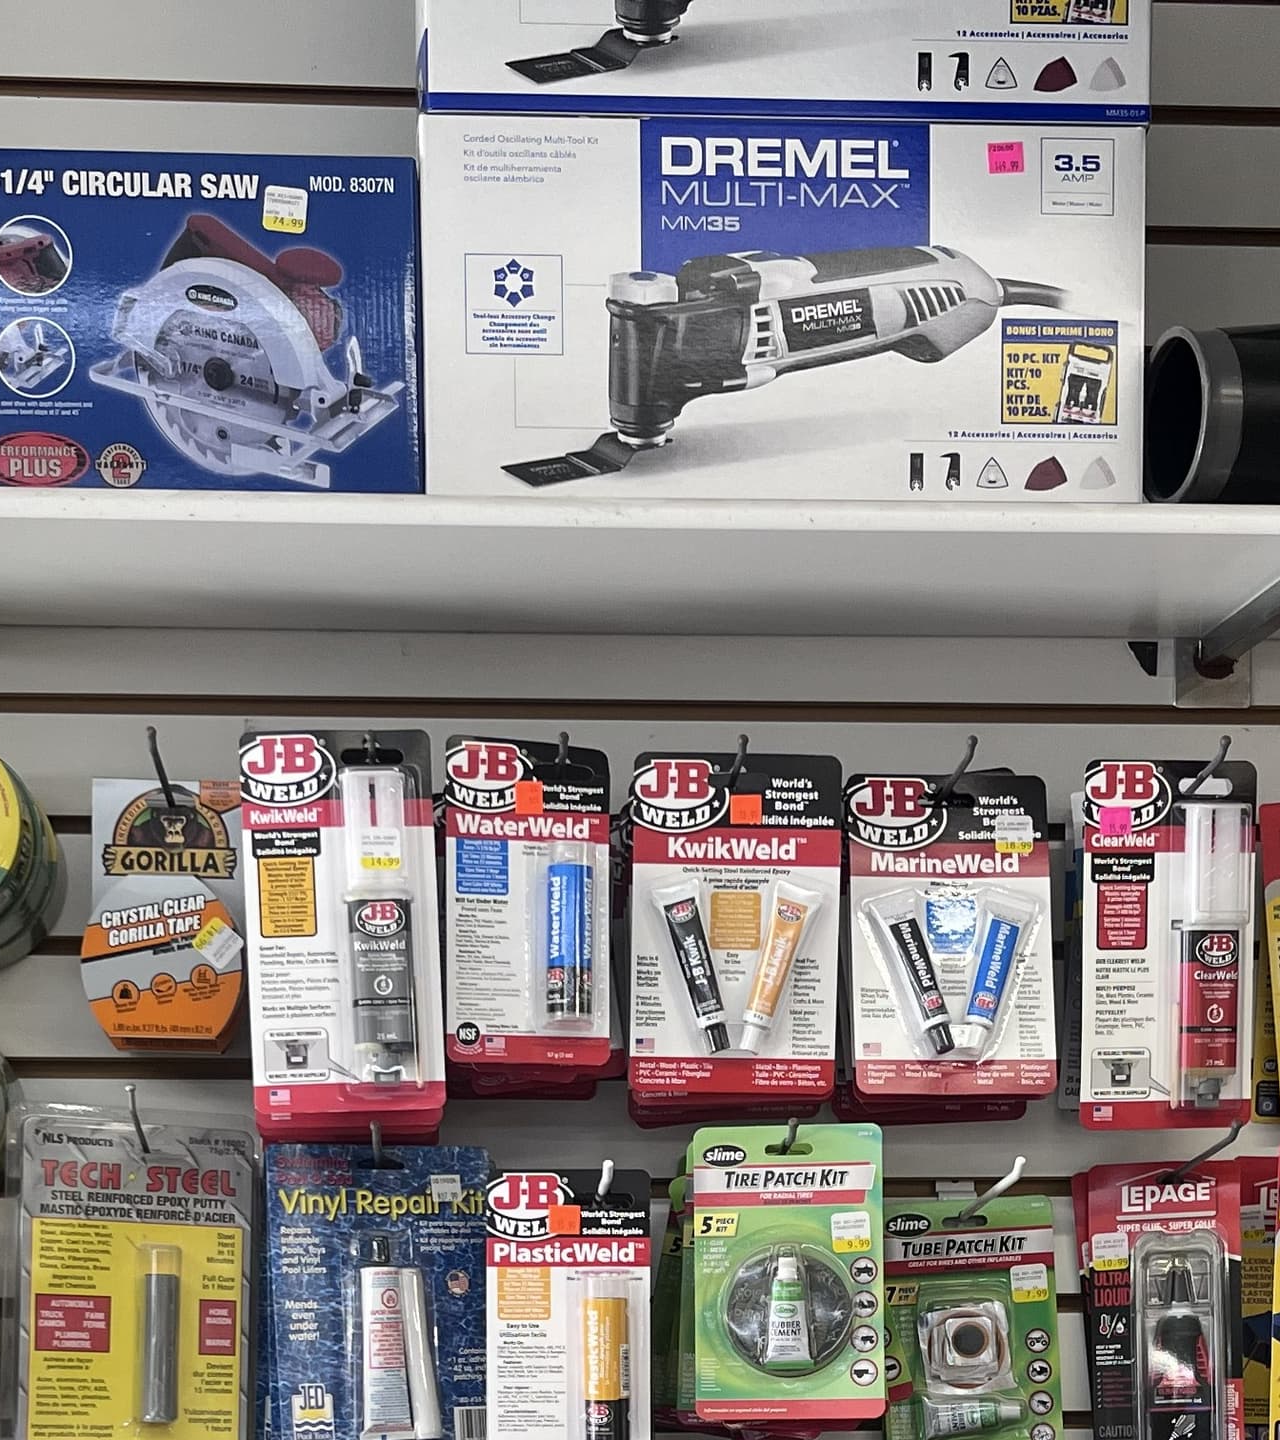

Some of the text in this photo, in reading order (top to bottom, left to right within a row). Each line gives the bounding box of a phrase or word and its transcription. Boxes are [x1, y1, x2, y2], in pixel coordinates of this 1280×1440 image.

[463, 135, 599, 145] Corded Oscillating Multi-Tool Kit
[662, 137, 910, 179] DREMEL
[1055, 155, 1100, 172] 3.5
[62, 171, 192, 197] CIRCULAR
[199, 174, 259, 199] SAW
[310, 176, 394, 193] MOD. 8307N
[1061, 174, 1094, 182] AMP
[662, 182, 902, 209] MULTI-MAX
[662, 215, 740, 232] MM35
[1006, 326, 1037, 336] BONUS
[10, 457, 61, 478] PLUS
[250, 810, 317, 824] KwikWeld
[456, 814, 590, 840] WaterWeld
[669, 837, 796, 860] KwikWeld
[1091, 832, 1155, 847] ClearWeld
[121, 851, 220, 872] GORILLA
[370, 857, 400, 866] 14.99
[872, 852, 1019, 873] MarineWeld
[102, 895, 205, 928] CRYSTAL CLEAR
[109, 915, 200, 947] GORILLA TAPE
[705, 1147, 744, 1163] slime
[41, 1159, 236, 1196] TECH STEEL
[725, 1169, 848, 1188] TIRE PATCH KIT
[51, 1190, 226, 1209] STEEL REINFORCED EPOXY PUTTY
[278, 1190, 351, 1222] Vinyl
[1121, 1181, 1211, 1213] LEPAGE
[494, 1242, 635, 1263] PlasticWeld
[902, 1236, 1026, 1258] TUBE PATCH KIT
[1024, 1288, 1047, 1299] 7.99
